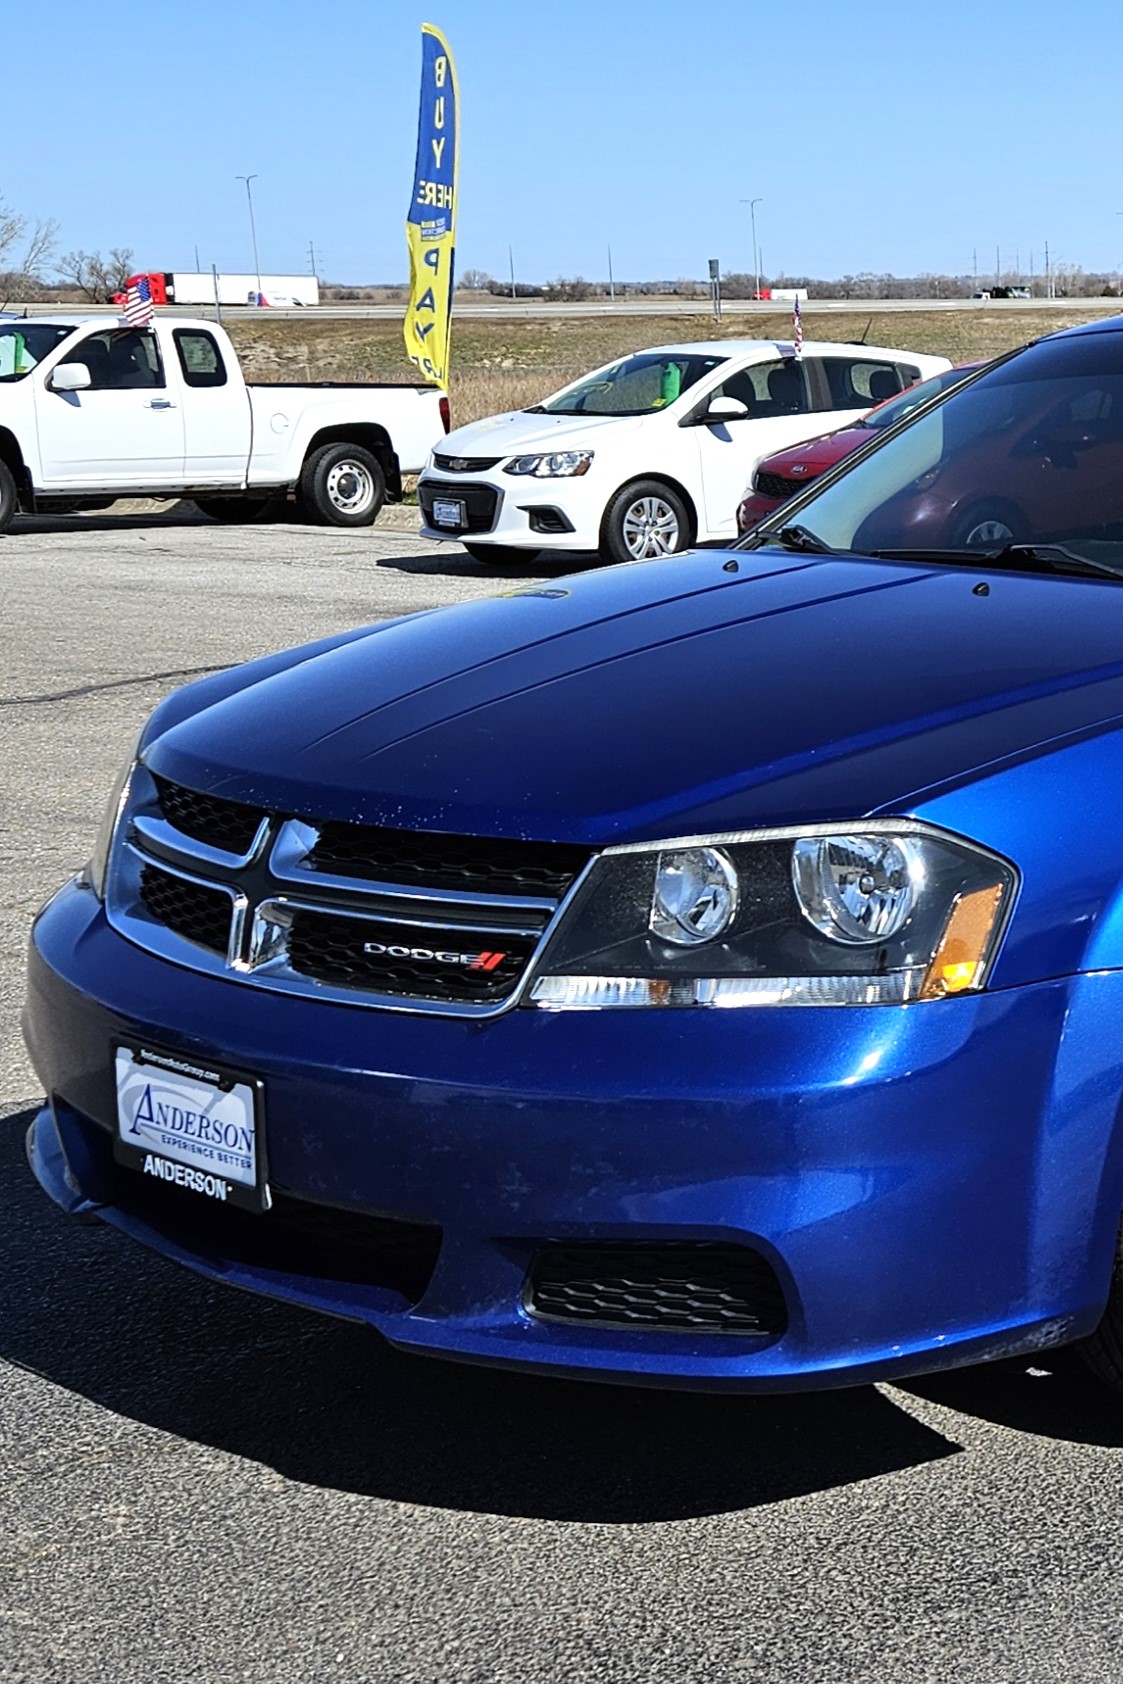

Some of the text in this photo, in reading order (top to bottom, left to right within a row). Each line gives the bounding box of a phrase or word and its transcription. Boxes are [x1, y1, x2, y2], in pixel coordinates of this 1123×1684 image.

[364, 942, 485, 967] DODGE
[129, 1083, 255, 1153] ANDERSON
[161, 1134, 252, 1170] EXPERIENCE BETTER
[143, 1154, 228, 1201] ANDERSON
